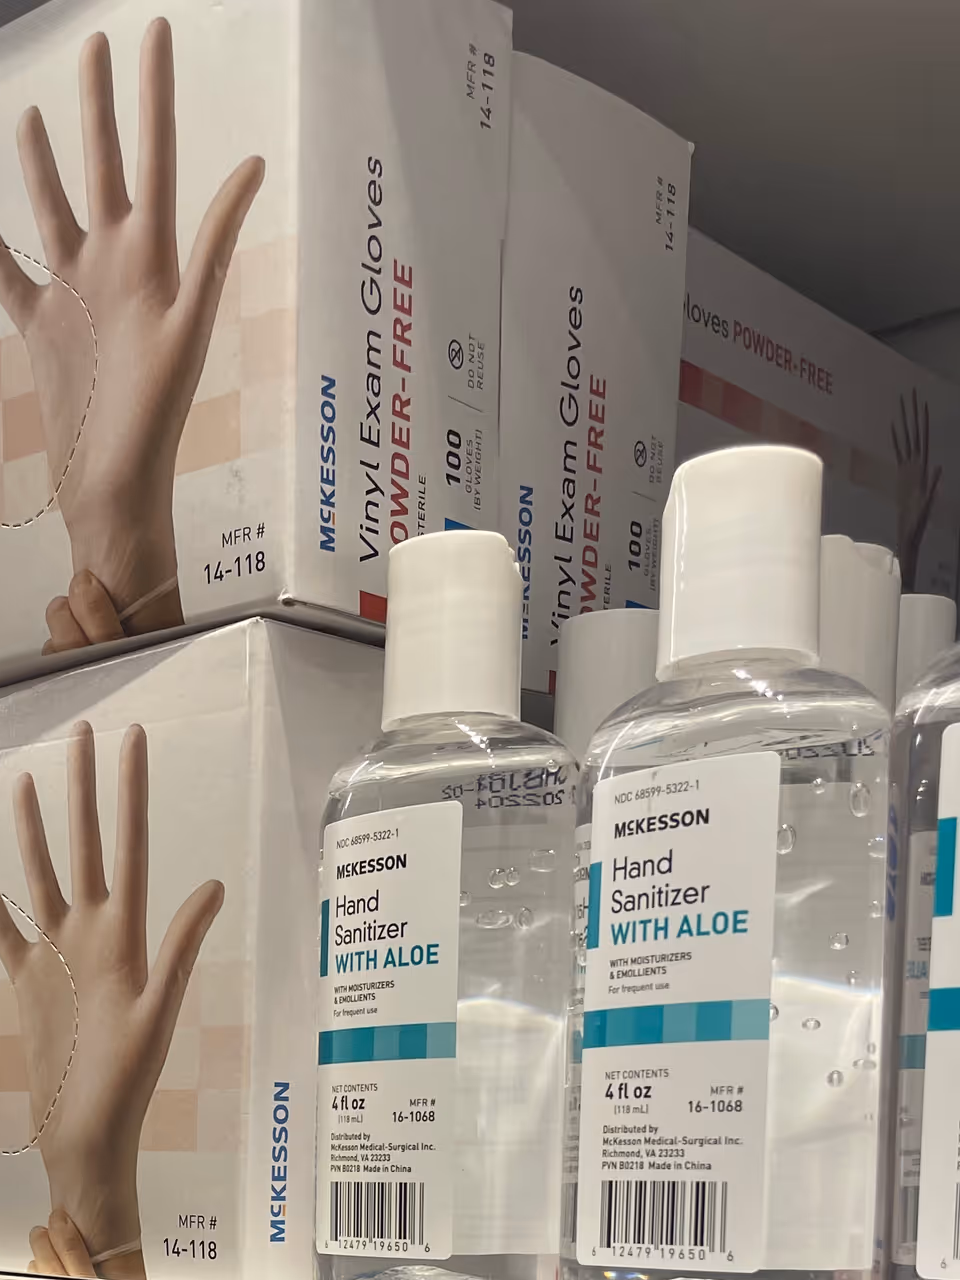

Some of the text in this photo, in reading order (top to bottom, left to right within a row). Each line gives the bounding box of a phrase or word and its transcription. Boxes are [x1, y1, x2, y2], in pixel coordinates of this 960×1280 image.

[480, 52, 495, 130] 14-118
[665, 183, 676, 252] 14-118
[559, 285, 584, 428] Gloves
[683, 293, 833, 395] loves POWDER-FREE
[359, 155, 386, 564] Vinyl Exam Gloves
[388, 257, 414, 547] OWDER-FREE
[445, 429, 463, 487] 100
[555, 439, 578, 544] Exam
[221, 522, 265, 548] MFR #
[628, 520, 643, 571] 100
[204, 551, 266, 584] 14-118
[614, 780, 700, 805] NDC 68599-5322-1
[336, 828, 400, 849] NDC 68599-5322-1
[612, 849, 673, 882] Hand
[335, 889, 380, 918] Hand
[611, 883, 711, 914] Sanitizer
[334, 919, 408, 947] Sanitizer
[610, 909, 749, 946] WITH ALOE
[335, 943, 440, 974] WITH ALOE
[609, 952, 692, 969] WITH MOISTURIZERS
[334, 980, 395, 995] WITH MOISTURIZERS
[608, 982, 670, 995] For frequent use
[605, 1068, 669, 1080] NET CONTENTS
[331, 1096, 365, 1111] 4 fl oz
[605, 1083, 652, 1099] 4 fl oz
[392, 1110, 436, 1123] 16-1068
[688, 1100, 743, 1113] 16-1068
[602, 1124, 659, 1135] Distributed by
[602, 1136, 743, 1148] McKesson Medical-Surgical Inc.
[330, 1142, 437, 1153] McKesson Medical-Surgical Inc.
[602, 1149, 685, 1160] Richmond, VA 23233
[178, 1214, 218, 1230] MFR #
[163, 1237, 217, 1260] 14-118
